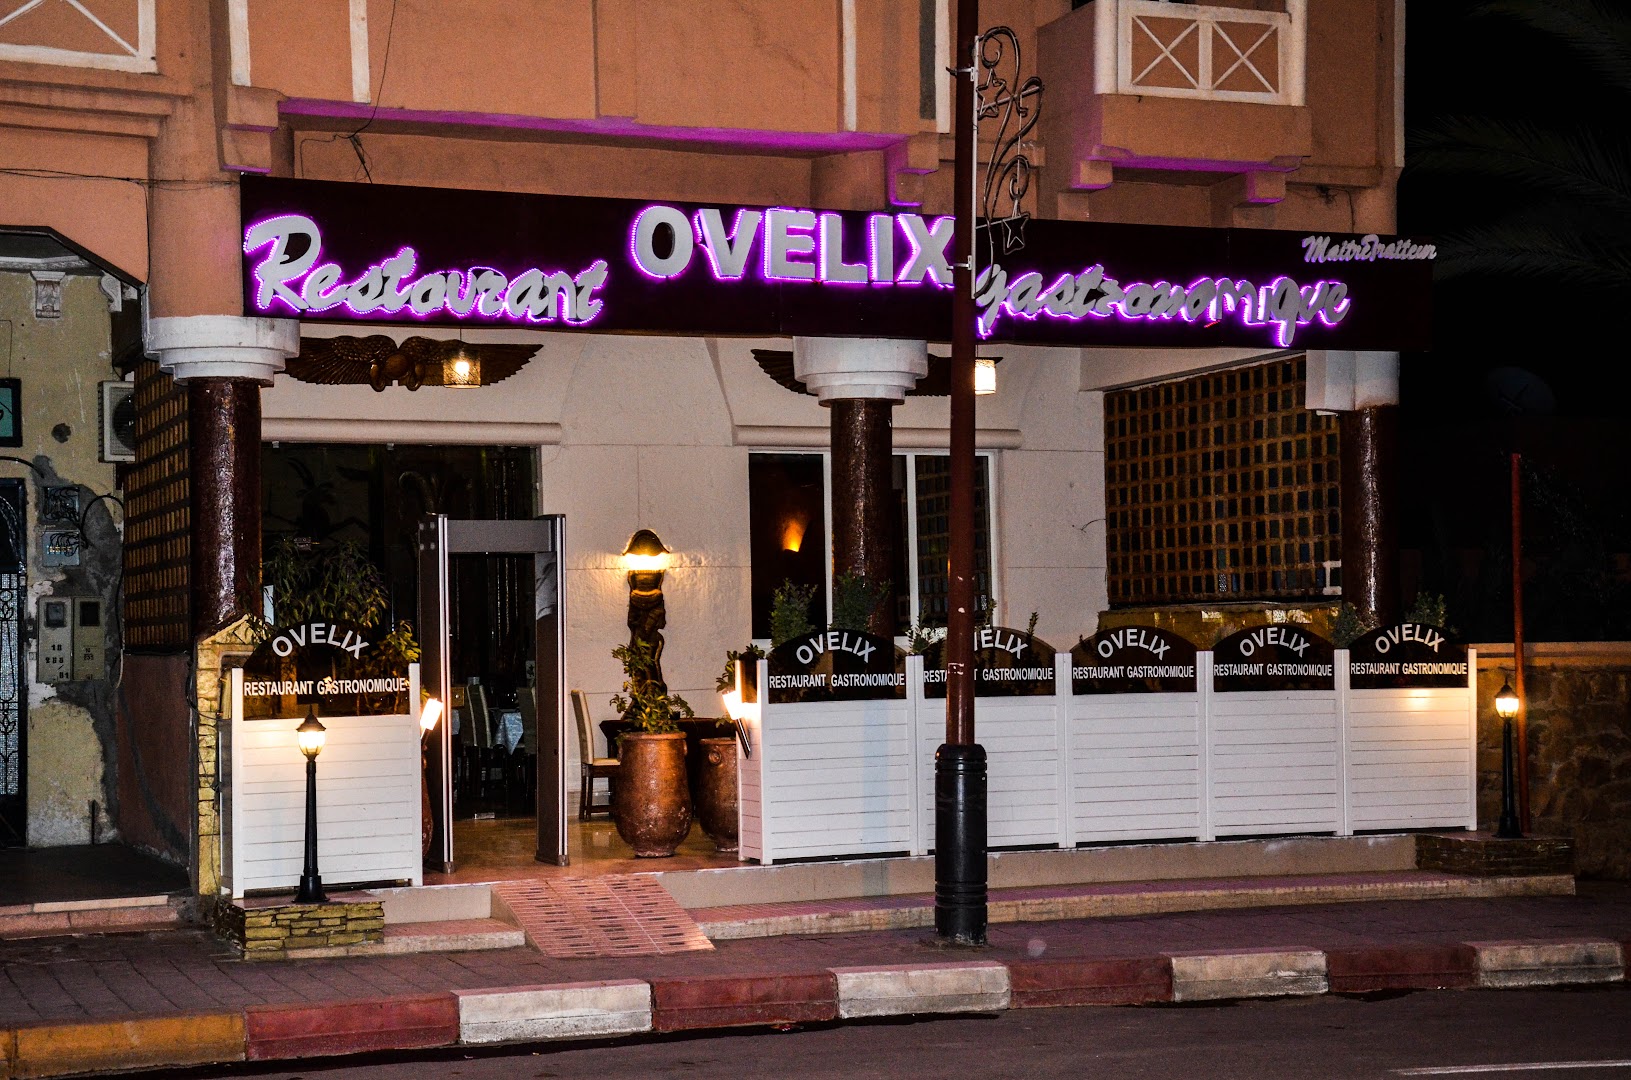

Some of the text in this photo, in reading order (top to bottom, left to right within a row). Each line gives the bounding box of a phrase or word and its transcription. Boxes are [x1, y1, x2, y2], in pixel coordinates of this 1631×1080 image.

[243, 214, 608, 325] Restaurant
[631, 205, 955, 288] OVELIX
[272, 622, 370, 659] OVELIX
[796, 631, 877, 664] OVELIX
[974, 629, 1029, 659] ELIX
[1097, 628, 1171, 661] OVELIX
[1240, 627, 1311, 658] OVELIX
[1375, 623, 1445, 653] OVELIX
[769, 673, 905, 689] RESTAURANT GASTRONOMIQUE
[982, 667, 1054, 681] GASTRONOMIQUE
[1073, 665, 1195, 679] RESTAURANT GASTRONOMIQUE
[1213, 663, 1333, 677] RESTAURANT GASTRONOMIQUE
[1350, 662, 1468, 675] RESTAURANT GASTRONOMIQUE
[244, 677, 406, 697] RESTAURANT GASTRONOMIQUE
